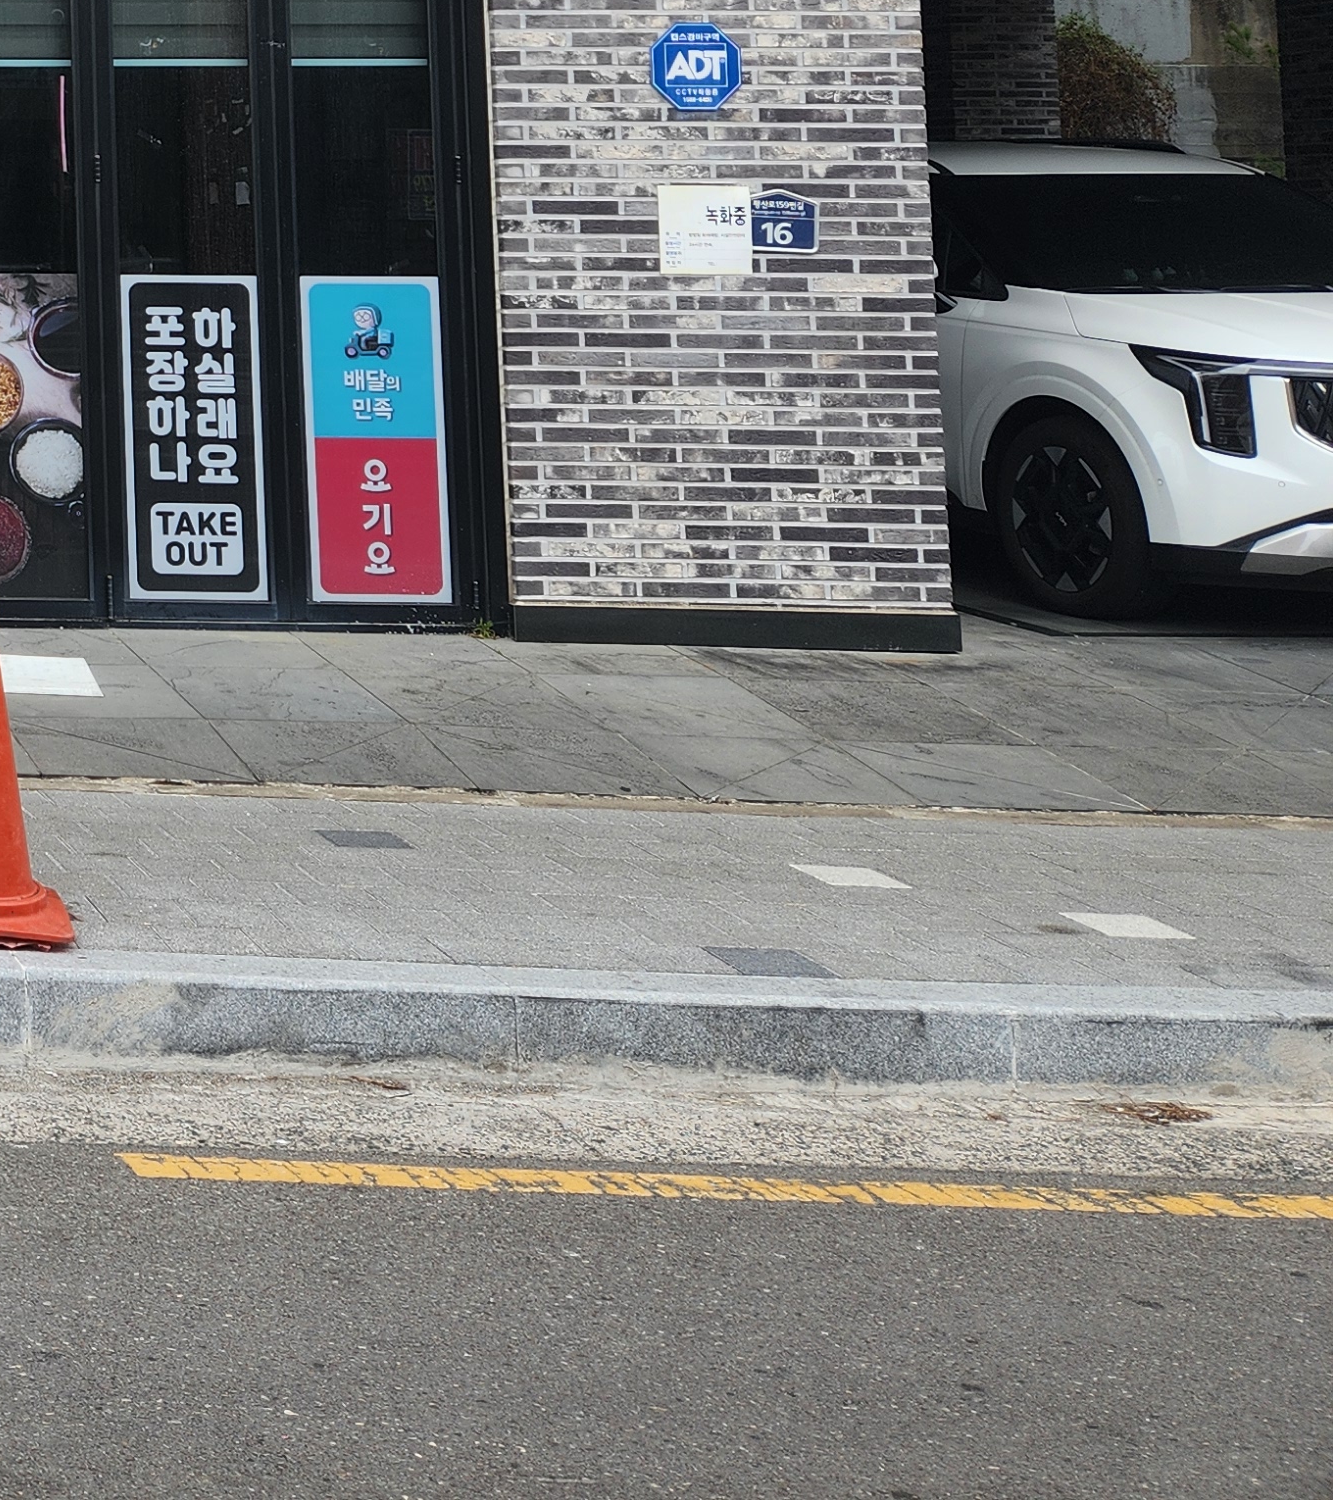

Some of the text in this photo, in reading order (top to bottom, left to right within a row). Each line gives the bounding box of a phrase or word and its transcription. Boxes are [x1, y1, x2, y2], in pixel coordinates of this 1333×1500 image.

[666, 49, 727, 80] ADT
[705, 205, 747, 226] 녹화중
[761, 222, 794, 245] 16
[343, 369, 402, 393] 배달의
[145, 306, 192, 483] 포장하나
[194, 307, 239, 484] 하실래요
[352, 397, 394, 421] 민족
[155, 511, 238, 536] TAKE
[360, 458, 396, 575] 요기요
[165, 541, 228, 566] OUT
